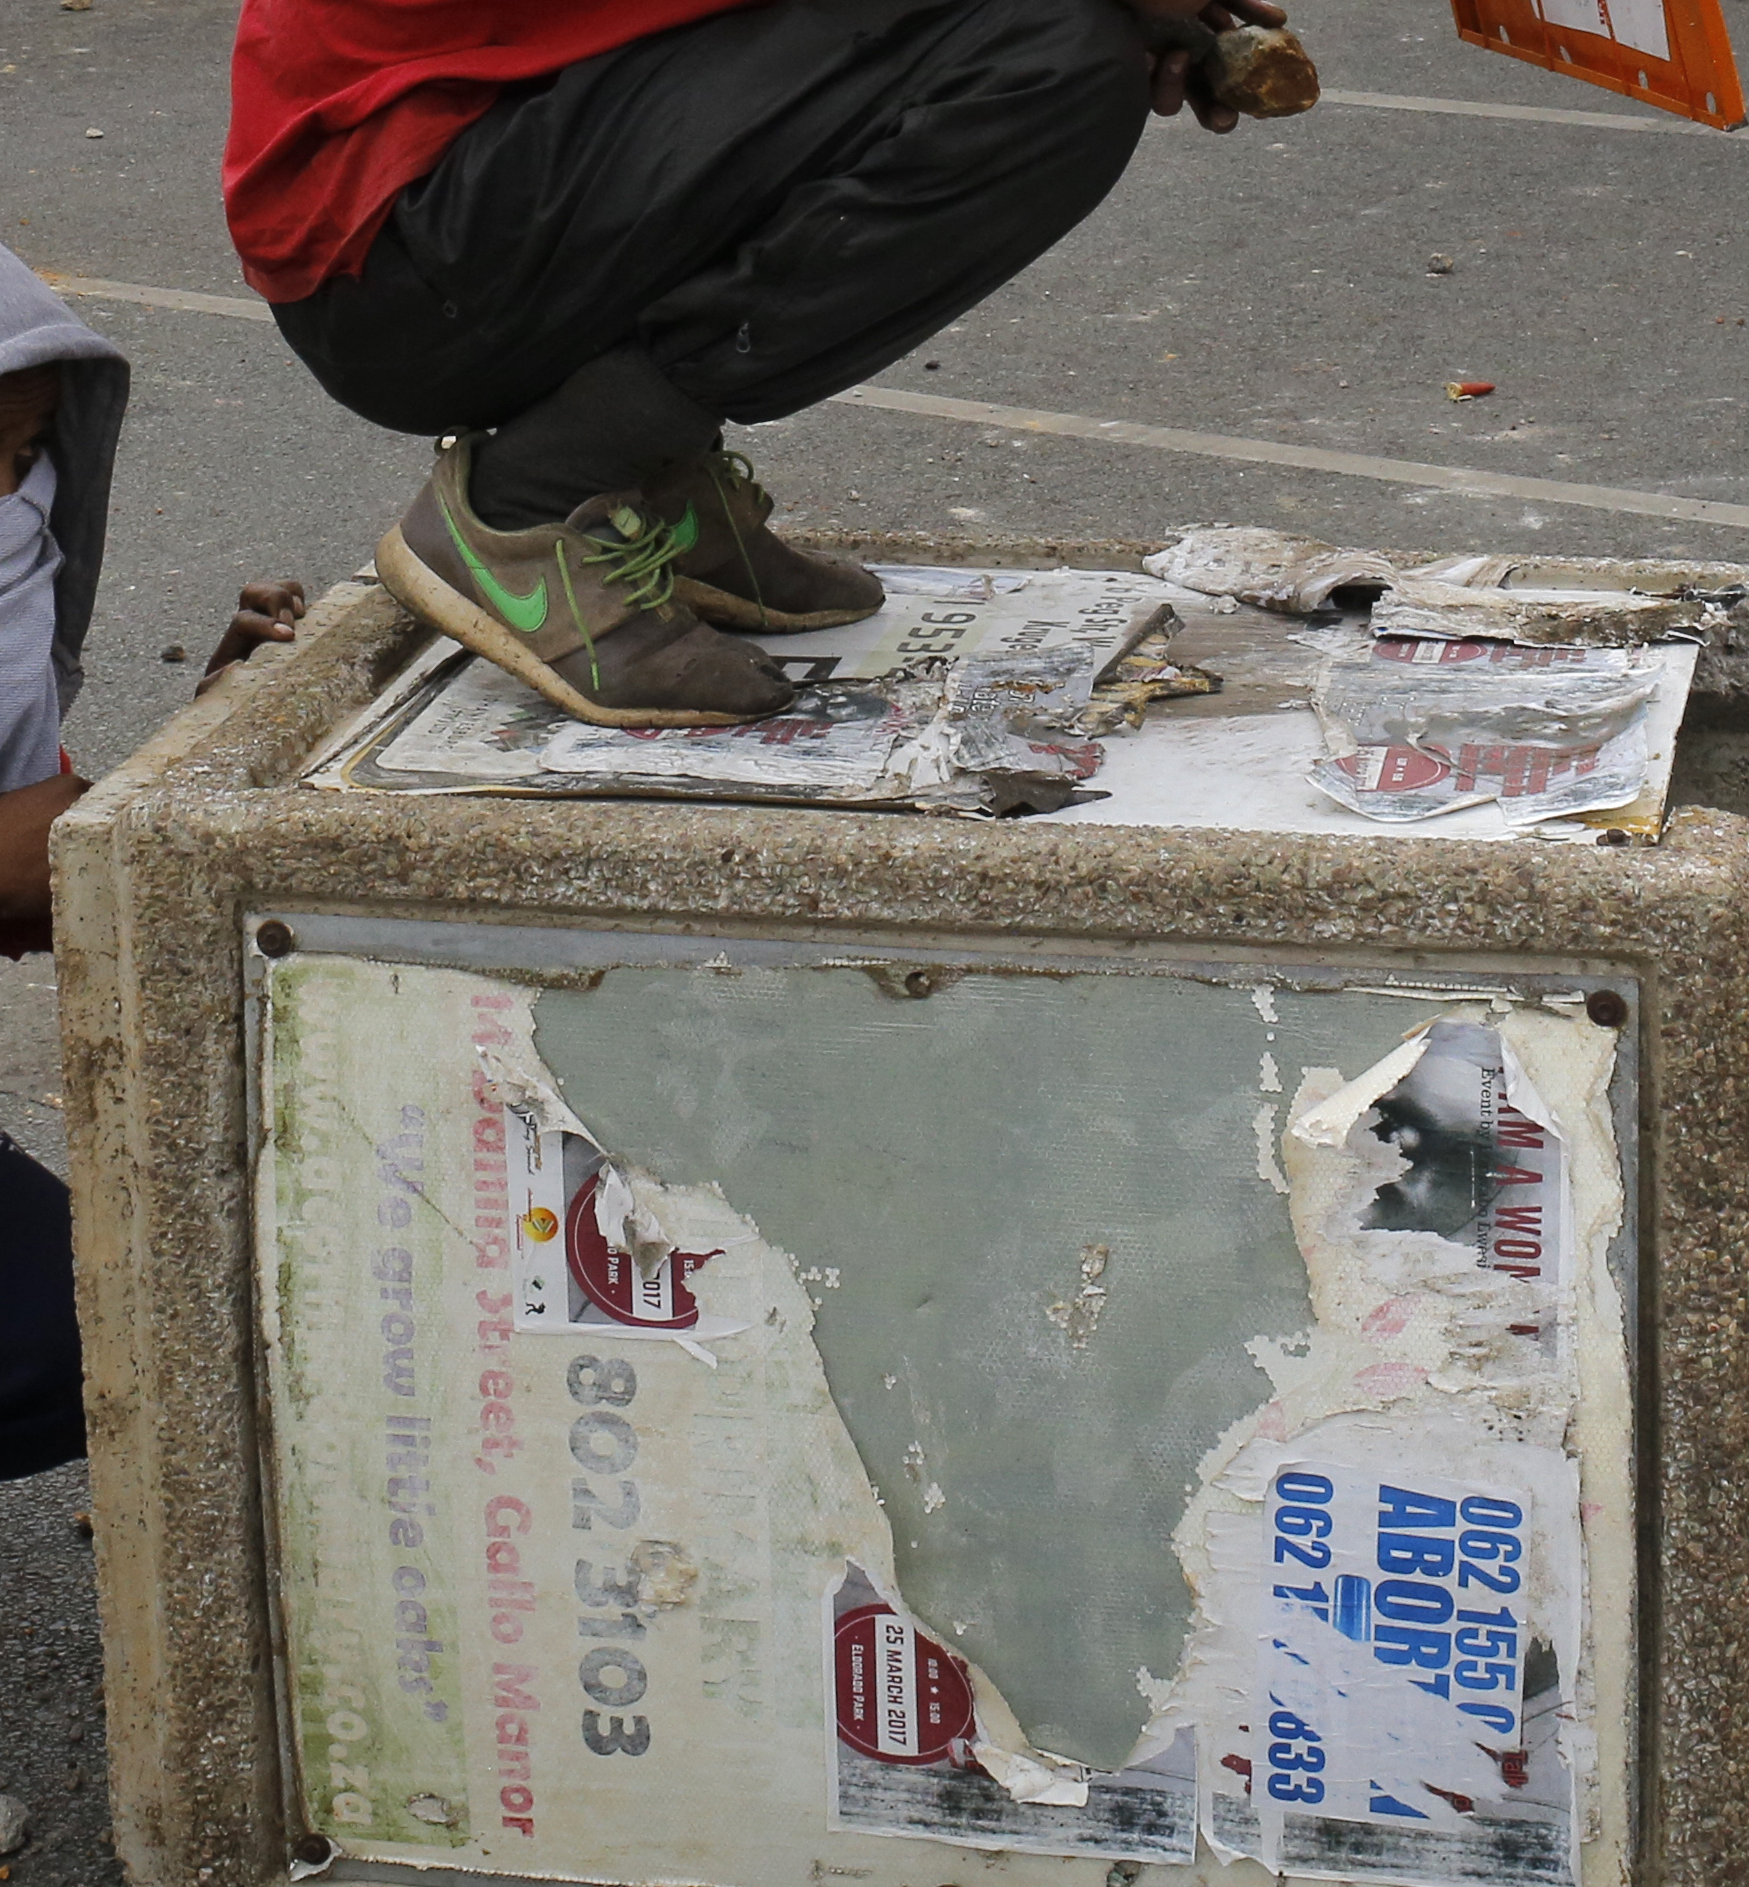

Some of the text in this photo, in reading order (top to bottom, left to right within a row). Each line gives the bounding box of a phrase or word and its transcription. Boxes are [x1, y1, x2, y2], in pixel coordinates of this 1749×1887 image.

[1000, 620, 1071, 651] Kruge
[1078, 595, 1137, 616] Peg
[1478, 1121, 1494, 1140] by
[1480, 1067, 1495, 1116] Event
[1495, 1165, 1543, 1186] A
[606, 1257, 620, 1285] PARK
[371, 1247, 419, 1398] grow
[473, 1290, 521, 1476] Street,
[385, 1414, 437, 1550] little
[1274, 1472, 1334, 1570] 062
[483, 1495, 537, 1645] Gallo
[567, 1355, 652, 1760] 802 3103
[1457, 1496, 1523, 1594] 062
[850, 1644, 866, 1721] ELDORADO PARK
[885, 1624, 908, 1746] 25 MARCH 2017
[1454, 1607, 1519, 1691] 155
[492, 1663, 539, 1838] Manor
[928, 1702, 941, 1724] 15:00
[1267, 1692, 1326, 1805] 833
[1502, 1750, 1529, 1790] Talk
